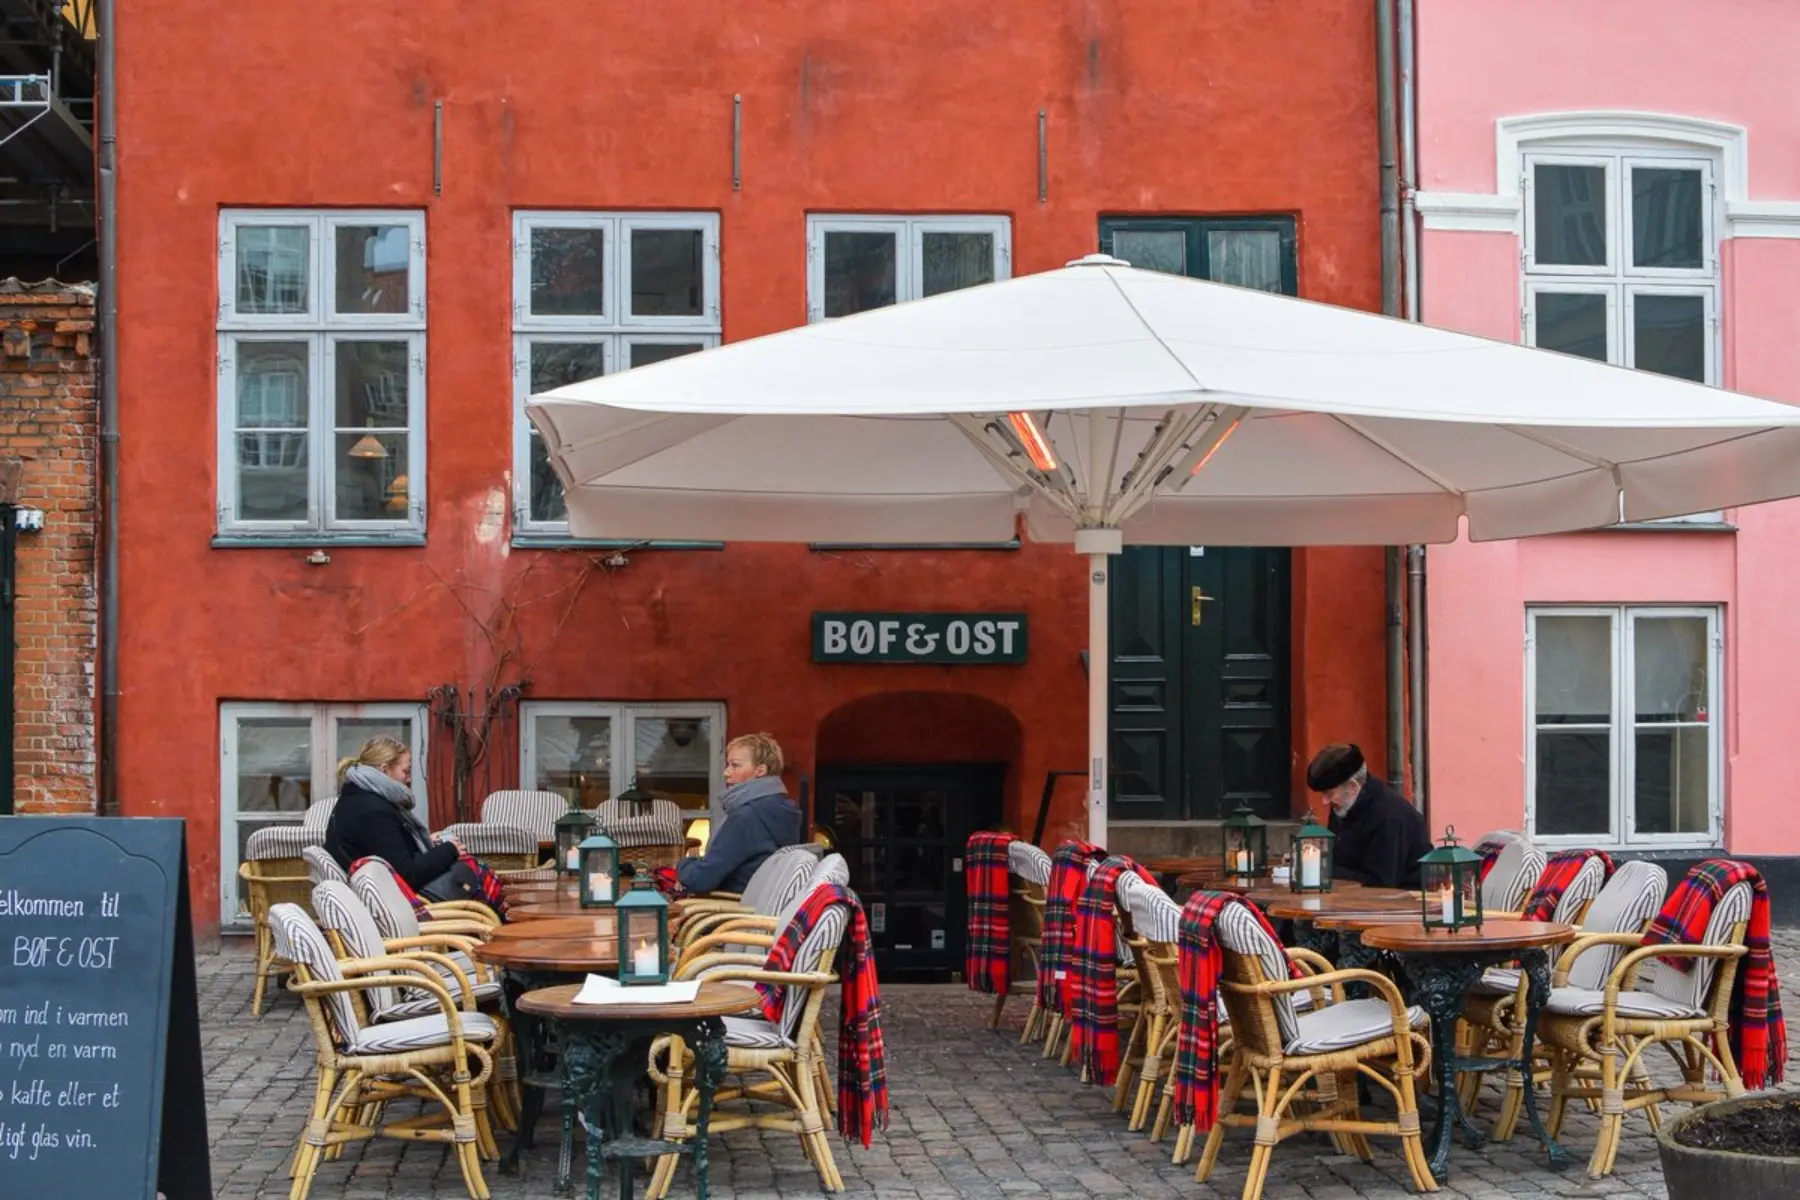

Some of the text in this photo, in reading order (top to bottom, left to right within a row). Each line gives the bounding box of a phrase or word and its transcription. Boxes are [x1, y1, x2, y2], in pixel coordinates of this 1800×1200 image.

[823, 620, 1020, 655] BØF & OST
[0, 889, 119, 917] elkommen til
[13, 936, 57, 967] BØF
[78, 936, 119, 969] OST
[24, 1000, 49, 1025] ind
[56, 1006, 63, 1024] i
[68, 1010, 129, 1027] varmen
[10, 1033, 40, 1071] nyd
[47, 1043, 67, 1058] en
[72, 1043, 117, 1059] varm
[11, 1079, 52, 1107] kaffe
[57, 1081, 97, 1107] eller
[102, 1083, 120, 1108] et
[29, 1122, 60, 1161] glas
[65, 1128, 97, 1148] vin.
